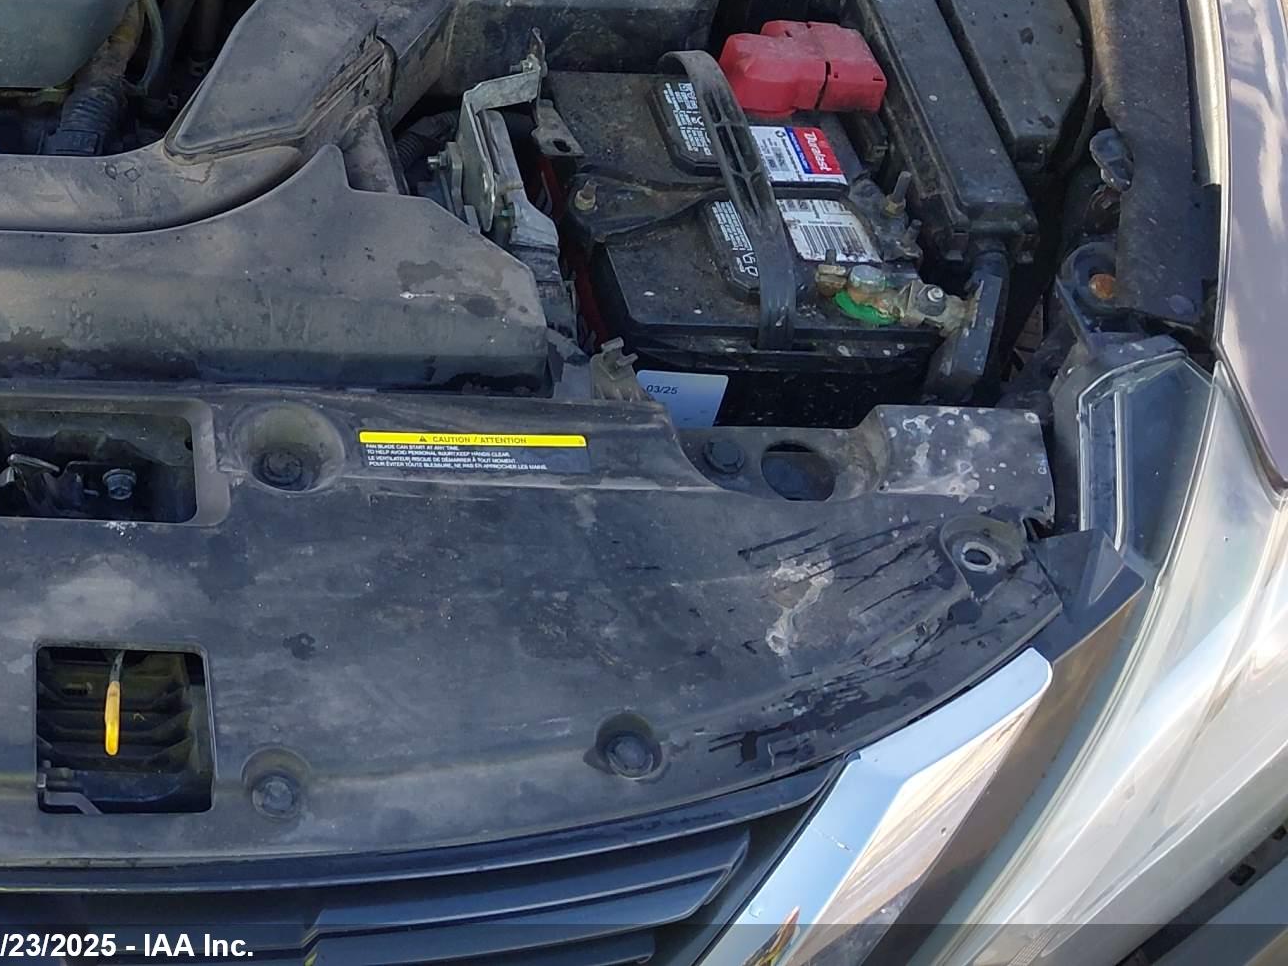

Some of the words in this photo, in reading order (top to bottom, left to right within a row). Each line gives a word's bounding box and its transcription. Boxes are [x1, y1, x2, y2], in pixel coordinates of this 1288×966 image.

[802, 131, 832, 172] Duralast
[646, 384, 679, 395] 03/25
[432, 436, 471, 444] CAUTION
[480, 436, 528, 445] ATTENTION
